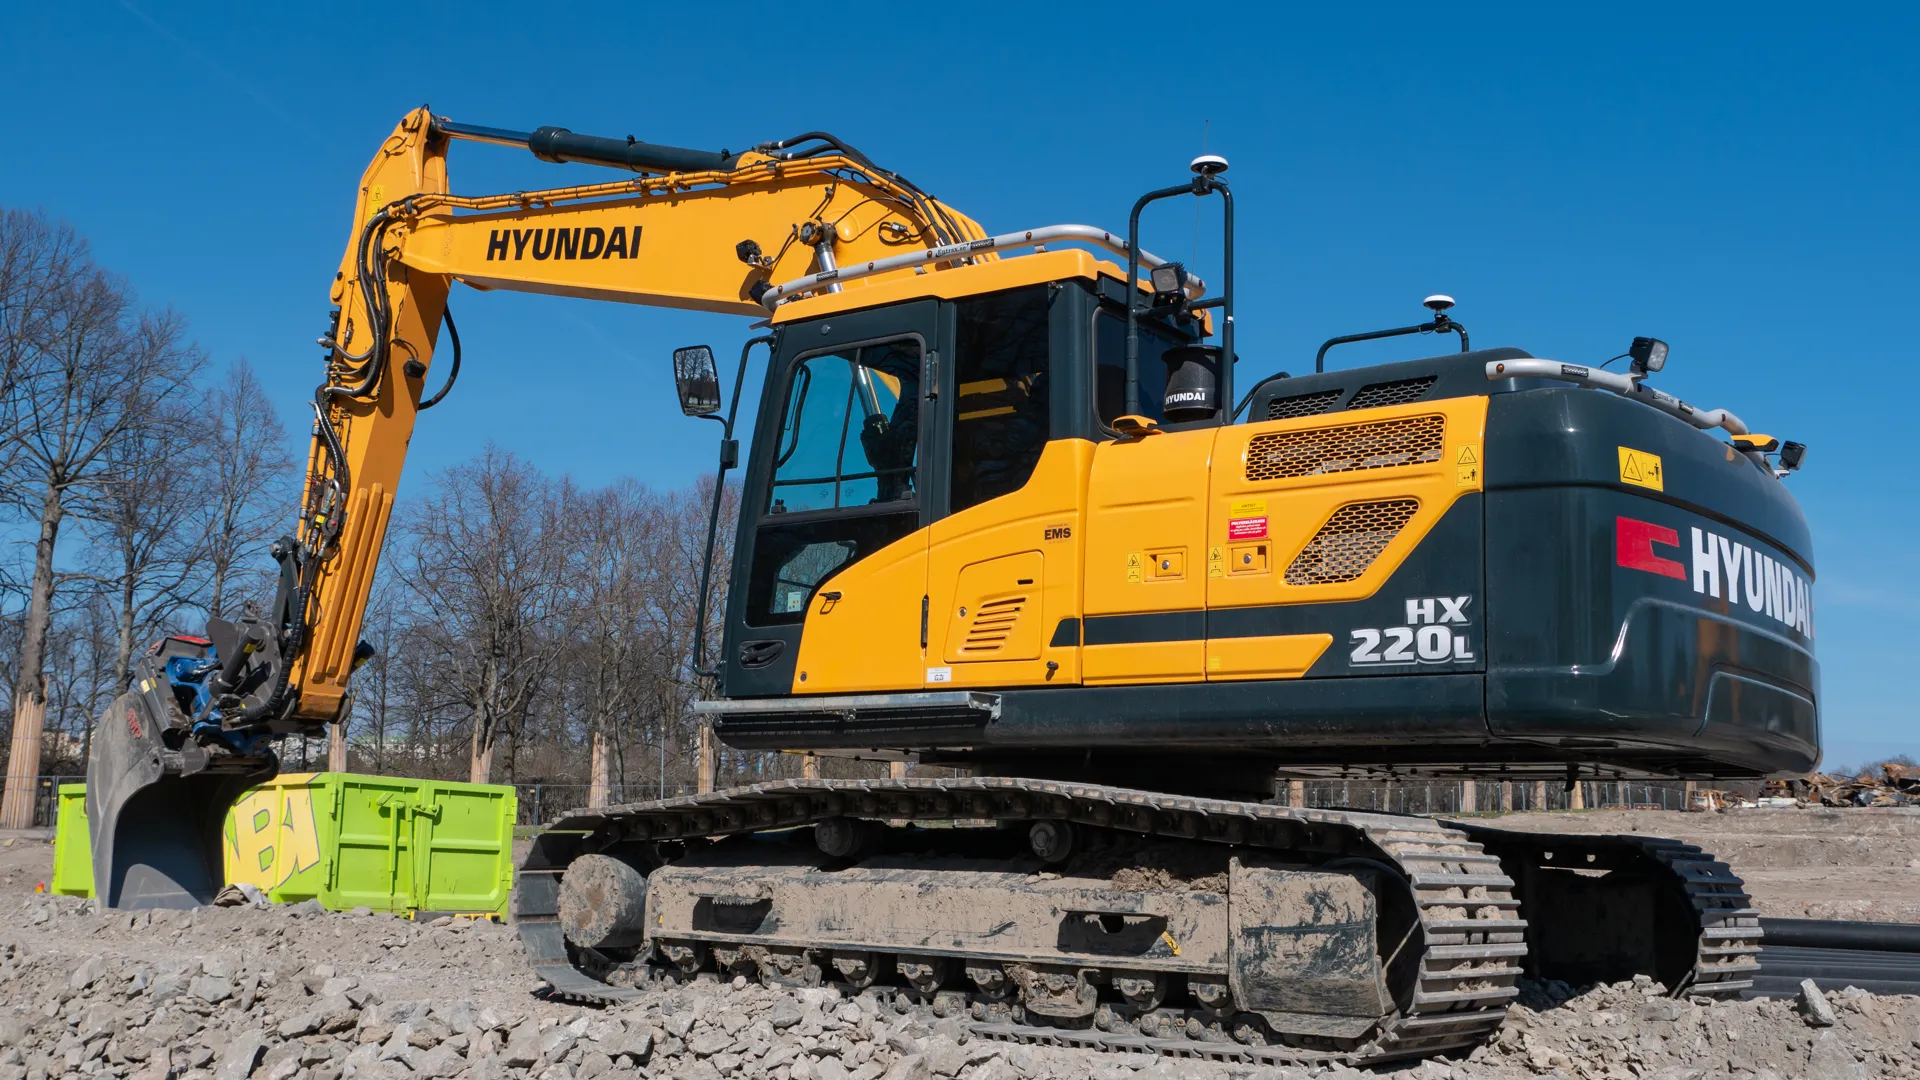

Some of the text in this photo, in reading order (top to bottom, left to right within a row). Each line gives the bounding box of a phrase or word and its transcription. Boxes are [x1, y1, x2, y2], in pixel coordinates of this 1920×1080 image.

[486, 225, 643, 261] HYUNDAI
[1165, 392, 1206, 405] HYUNDAI
[1044, 527, 1071, 540] EMS
[1691, 526, 1811, 641] HYUNDAI
[1405, 596, 1470, 625] HX
